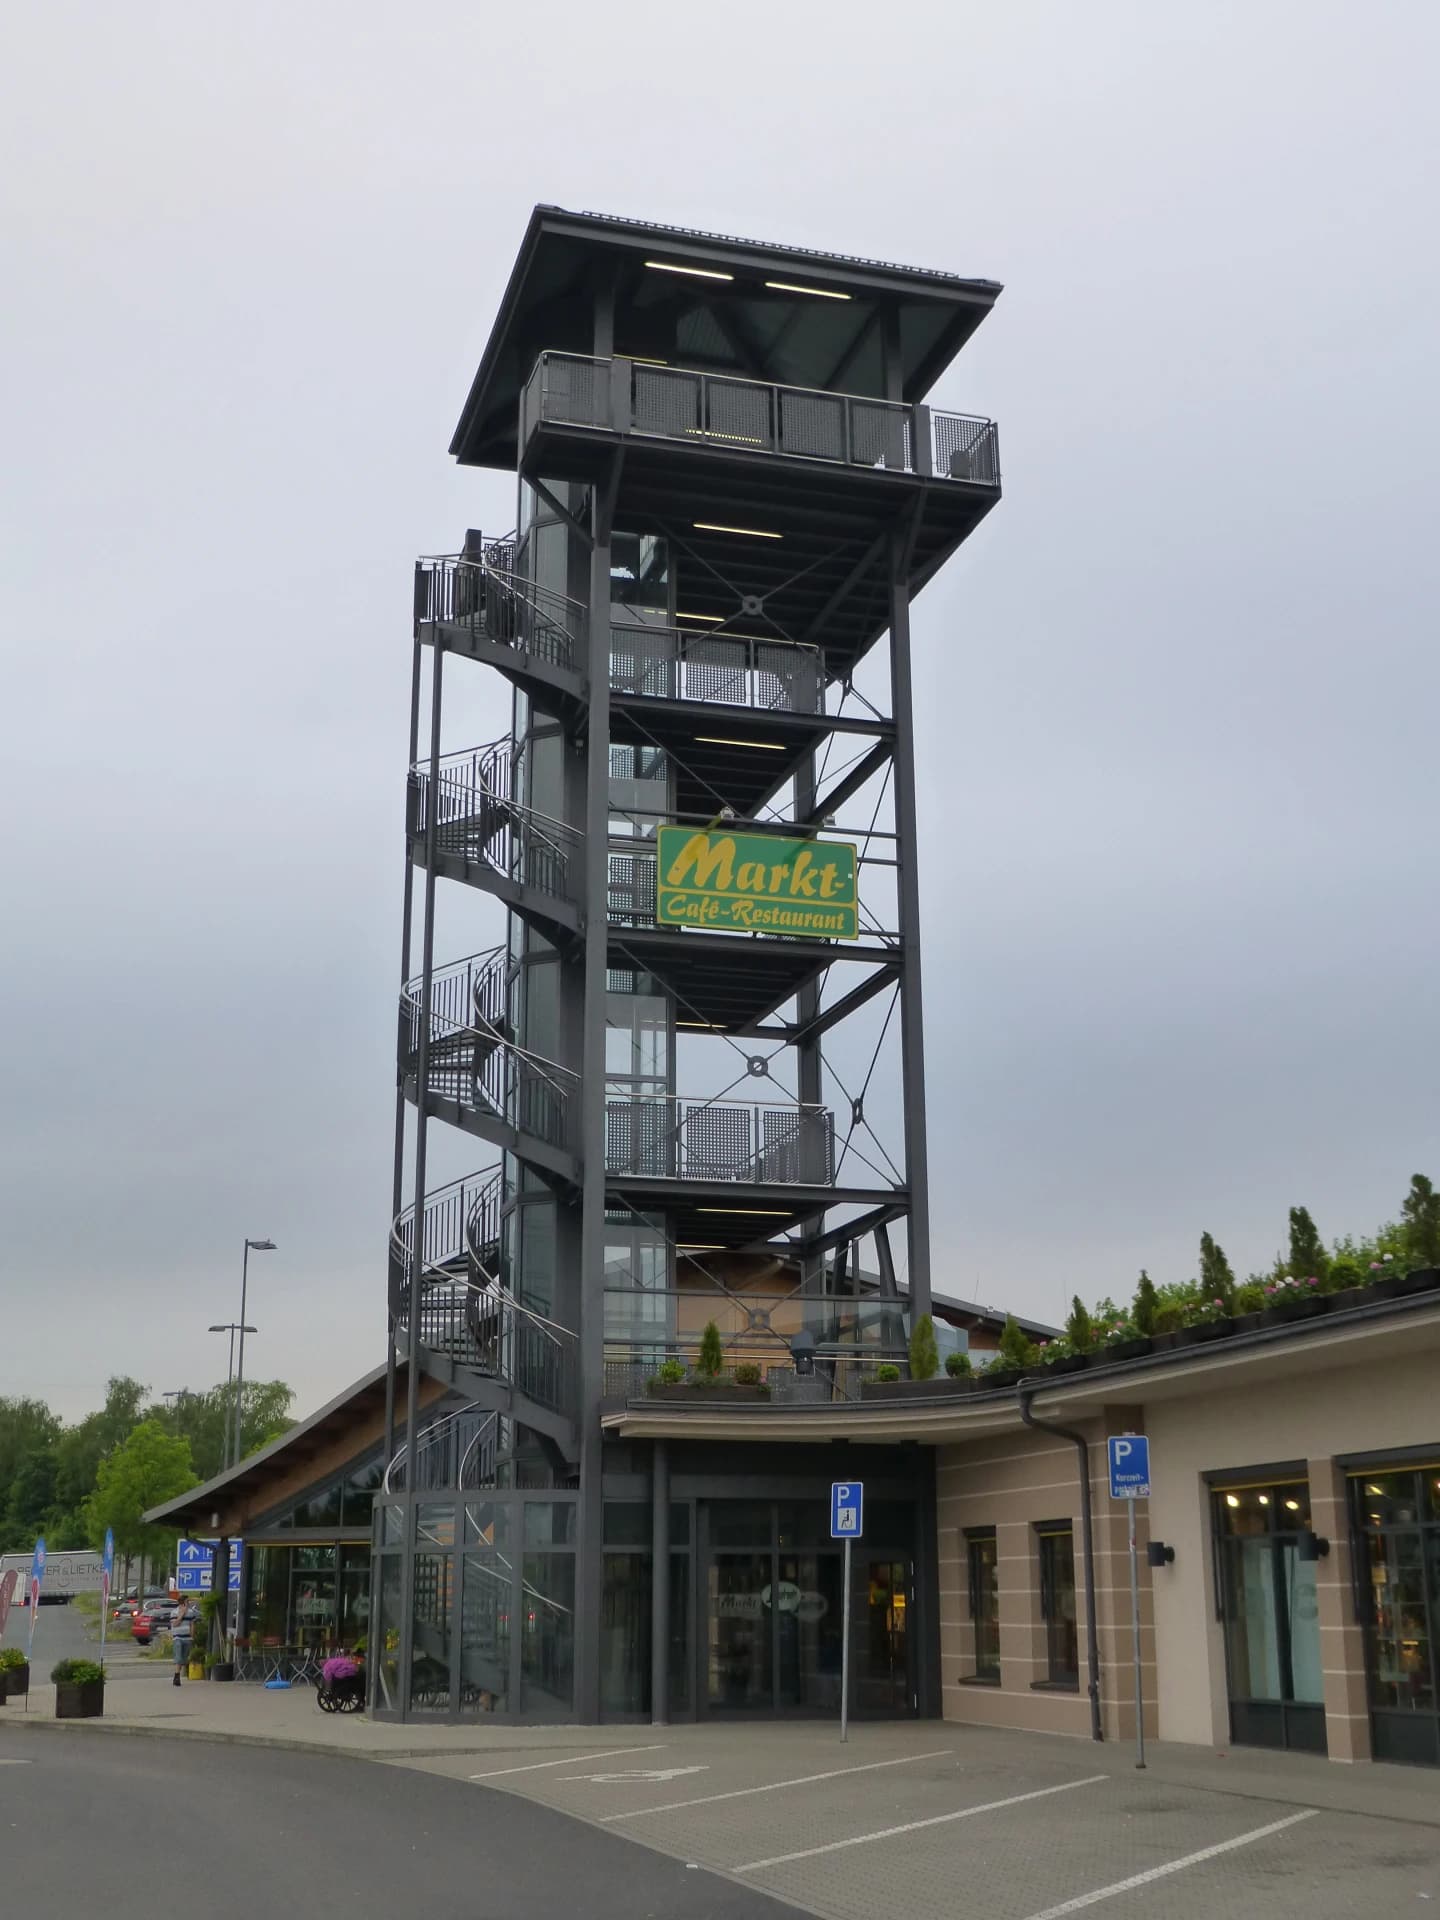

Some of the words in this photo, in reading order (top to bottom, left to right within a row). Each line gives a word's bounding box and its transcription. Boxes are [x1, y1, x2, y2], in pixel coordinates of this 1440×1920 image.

[667, 833, 845, 898] Markt-
[667, 894, 844, 930] Café-Restaurant
[1115, 1441, 1132, 1465] P
[837, 1486, 850, 1507] P
[183, 1572, 193, 1584] P
